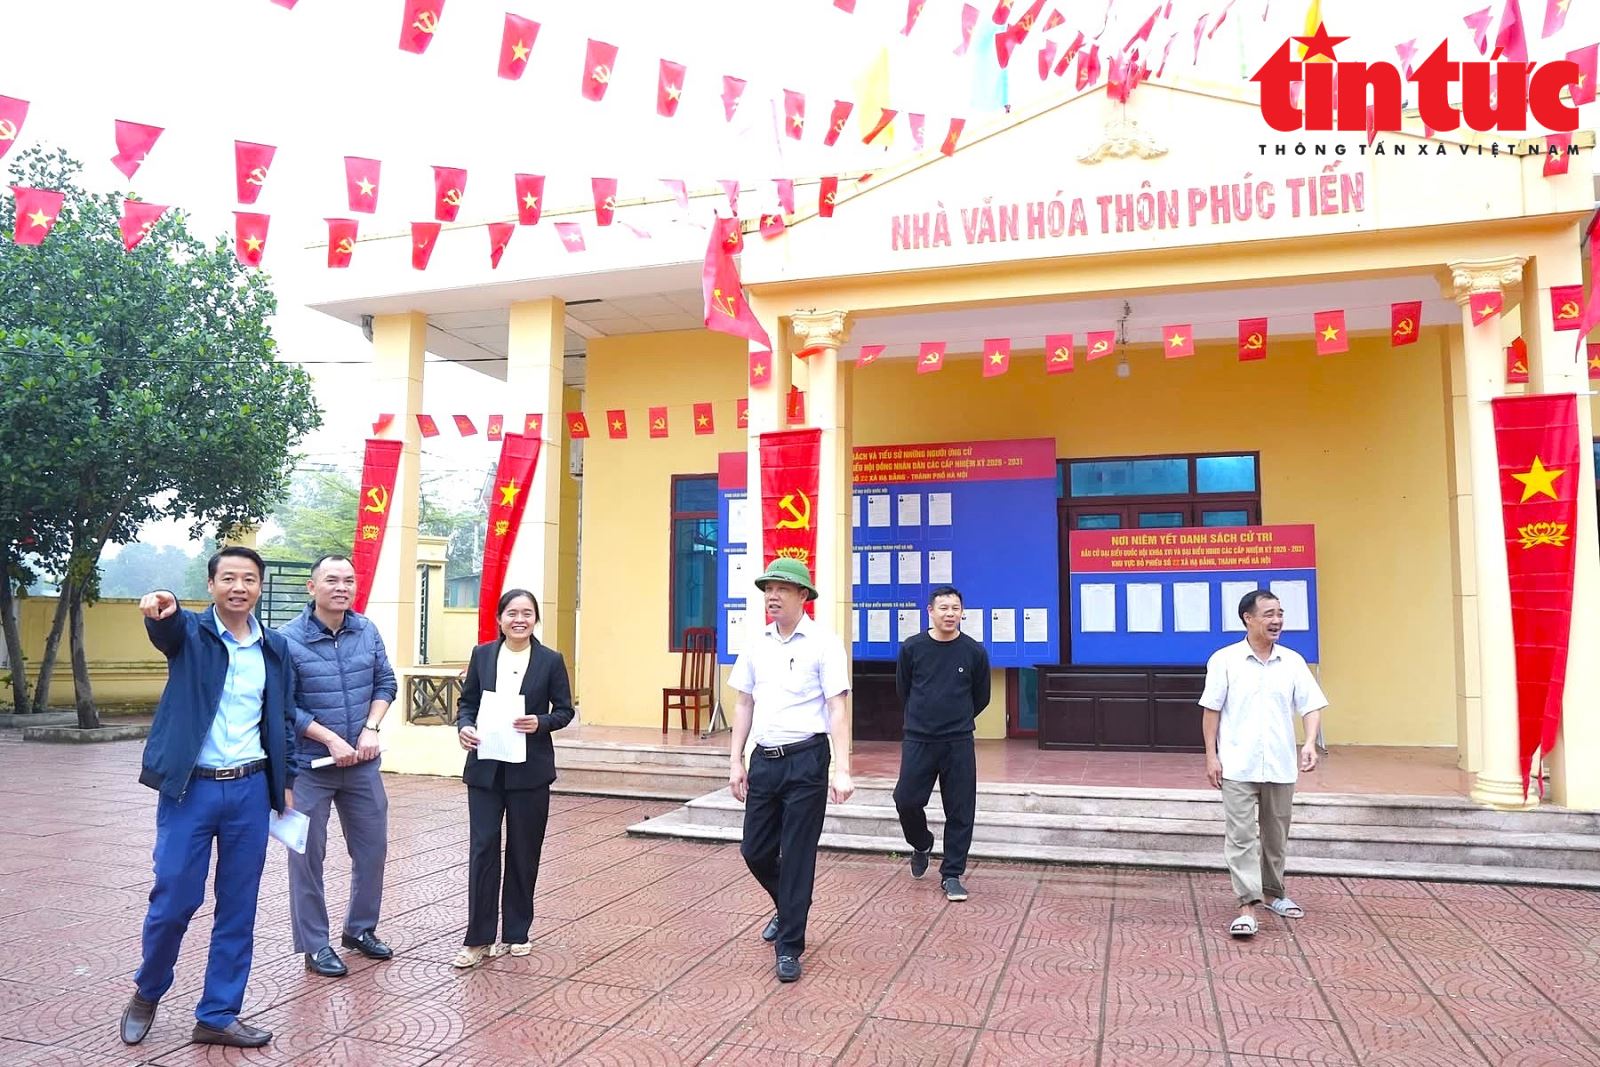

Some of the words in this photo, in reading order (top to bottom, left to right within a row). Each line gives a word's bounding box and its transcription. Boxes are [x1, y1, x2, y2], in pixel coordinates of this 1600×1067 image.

[891, 201, 953, 251] NHÀ
[960, 196, 1020, 245] VĂN
[1027, 190, 1089, 239] HÓA
[1096, 180, 1179, 234] THÔN
[1187, 171, 1276, 226] PHÚC
[1285, 160, 1366, 217] TIẾN
[1112, 536, 1128, 546] NƠI
[1132, 533, 1157, 545] NIÊM
[1160, 532, 1177, 544] YẾT
[1180, 534, 1207, 544] DANH
[1210, 532, 1237, 543] SÁCH
[1240, 530, 1255, 542] CỬ
[1256, 532, 1272, 542] TRI
